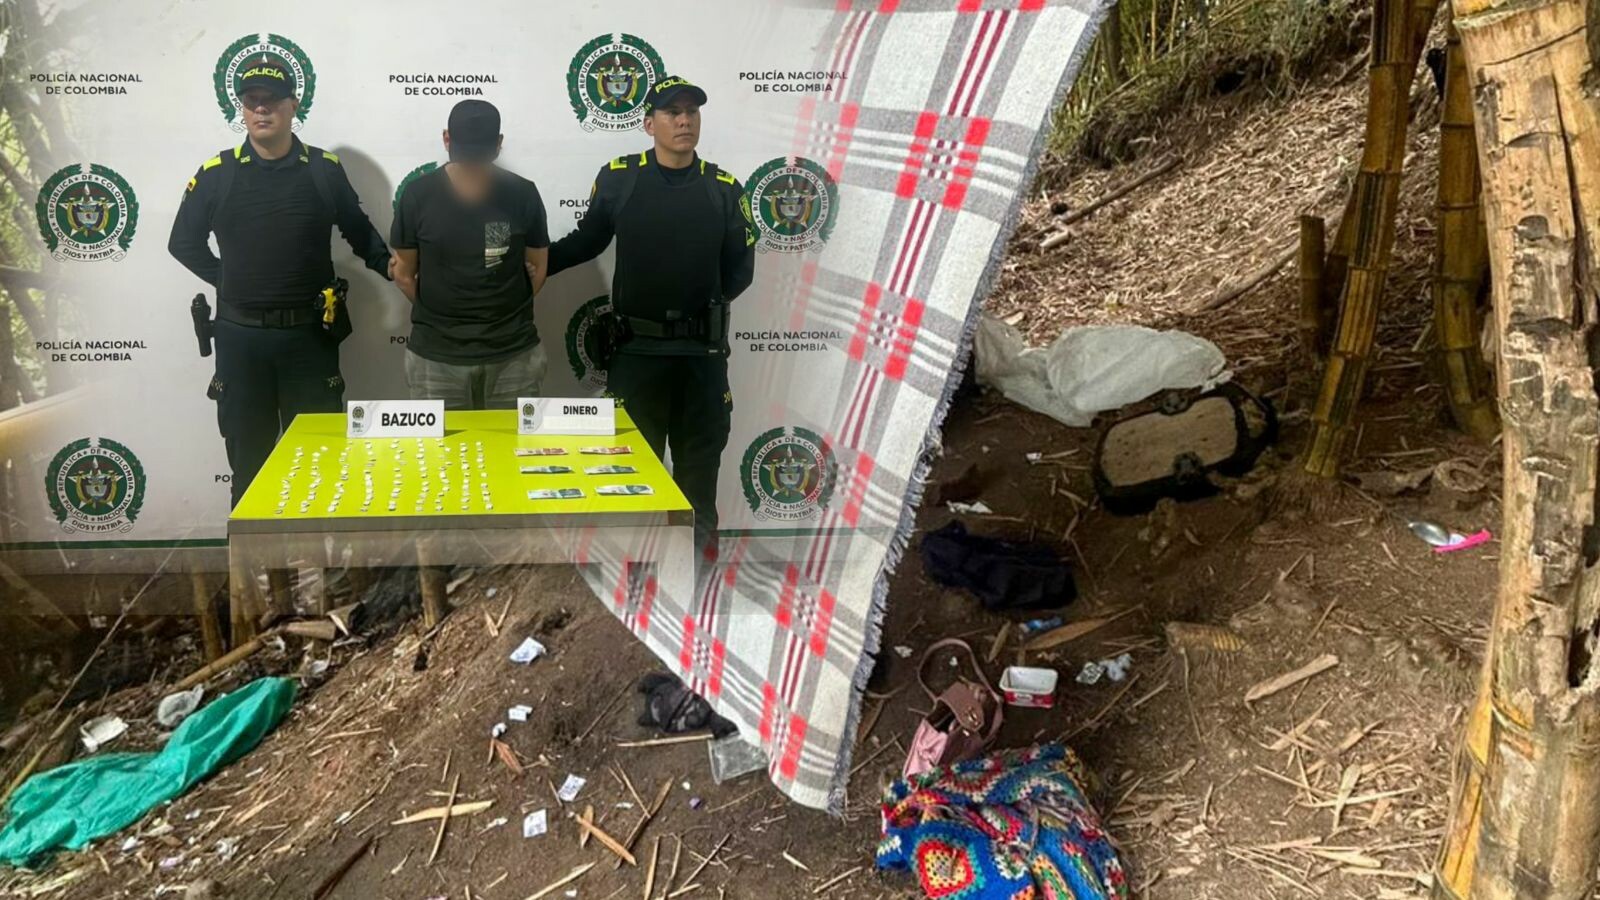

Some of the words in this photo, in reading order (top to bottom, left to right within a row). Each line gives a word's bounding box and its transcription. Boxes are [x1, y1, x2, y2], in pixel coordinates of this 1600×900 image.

[227, 48, 252, 89] REPUBLICA
[279, 49, 304, 89] COLOMBIA
[242, 67, 285, 80] POLICÍA
[580, 48, 605, 89] REPUBLICA
[29, 71, 77, 82] POLICÍA
[80, 73, 143, 83] NACIONAL
[389, 72, 435, 83] POLICÍA
[437, 74, 499, 83] NACIONAL
[739, 70, 785, 81] POLICÍA
[788, 71, 848, 80] NACIONAL
[45, 86, 61, 95] DE
[64, 86, 127, 95] COLOMBIA
[404, 87, 419, 96] DE
[422, 87, 483, 96] COLOMBIA
[754, 84, 769, 92] DE
[772, 83, 833, 92] COLOMBIA
[49, 178, 74, 219] REPUBLICA
[100, 178, 126, 218] COLOMBIA
[559, 199, 591, 208] POLIC
[54, 228, 80, 249] POLICIA
[89, 226, 124, 250] NACIONAL
[735, 329, 780, 340] POLICÍA
[783, 331, 843, 340] NACIONAL
[35, 339, 82, 350] POLICÍA
[85, 340, 147, 350] NACIONAL
[750, 343, 765, 352] DE
[768, 343, 828, 352] COLOMBIA
[51, 353, 67, 362] DE
[69, 352, 132, 362] COLOMBIA
[563, 405, 598, 415] DINERO
[381, 413, 436, 427] BAZUCO
